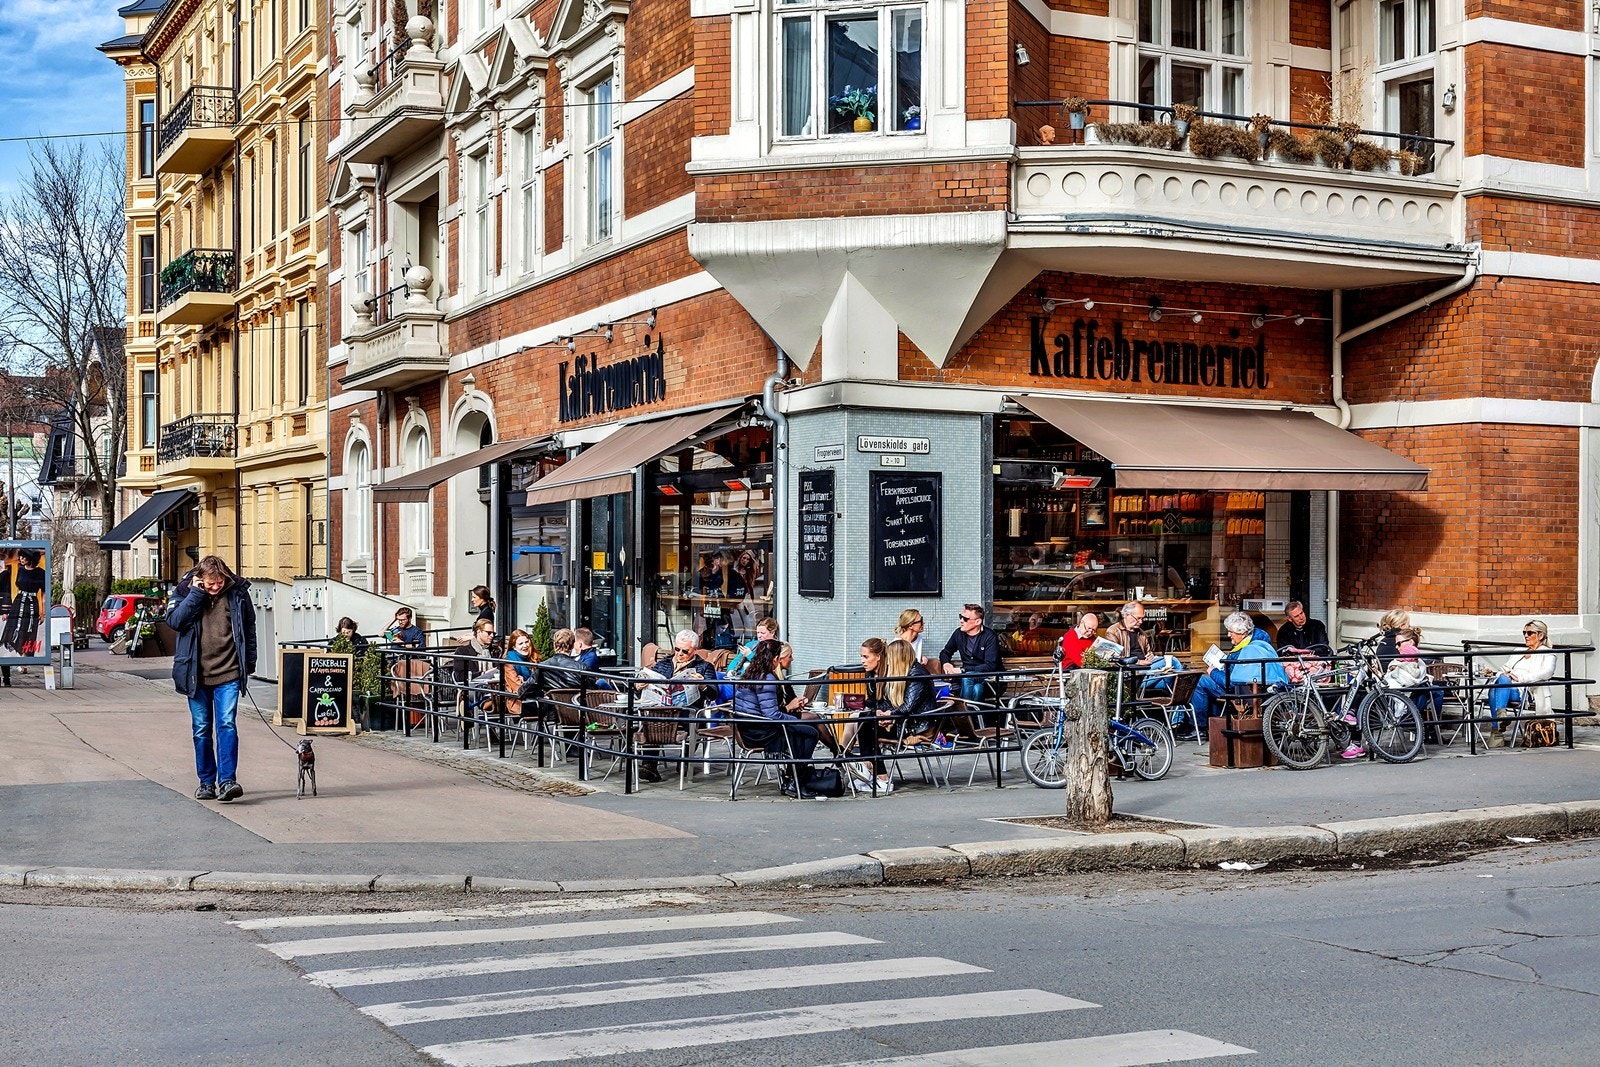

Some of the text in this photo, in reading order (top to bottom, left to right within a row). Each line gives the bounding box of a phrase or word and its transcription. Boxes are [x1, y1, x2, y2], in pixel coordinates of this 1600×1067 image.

[1029, 316, 1270, 390] Kaffebrenneriet
[558, 332, 667, 423] Kaffebrenneriet
[860, 438, 928, 452] Lövenskiolds gate
[885, 514, 924, 527] SVART KAFFE
[884, 555, 897, 567] FRA
[22, 641, 42, 654] H&M
[324, 675, 333, 687] &
[309, 686, 342, 694] CAPPUCCINO
